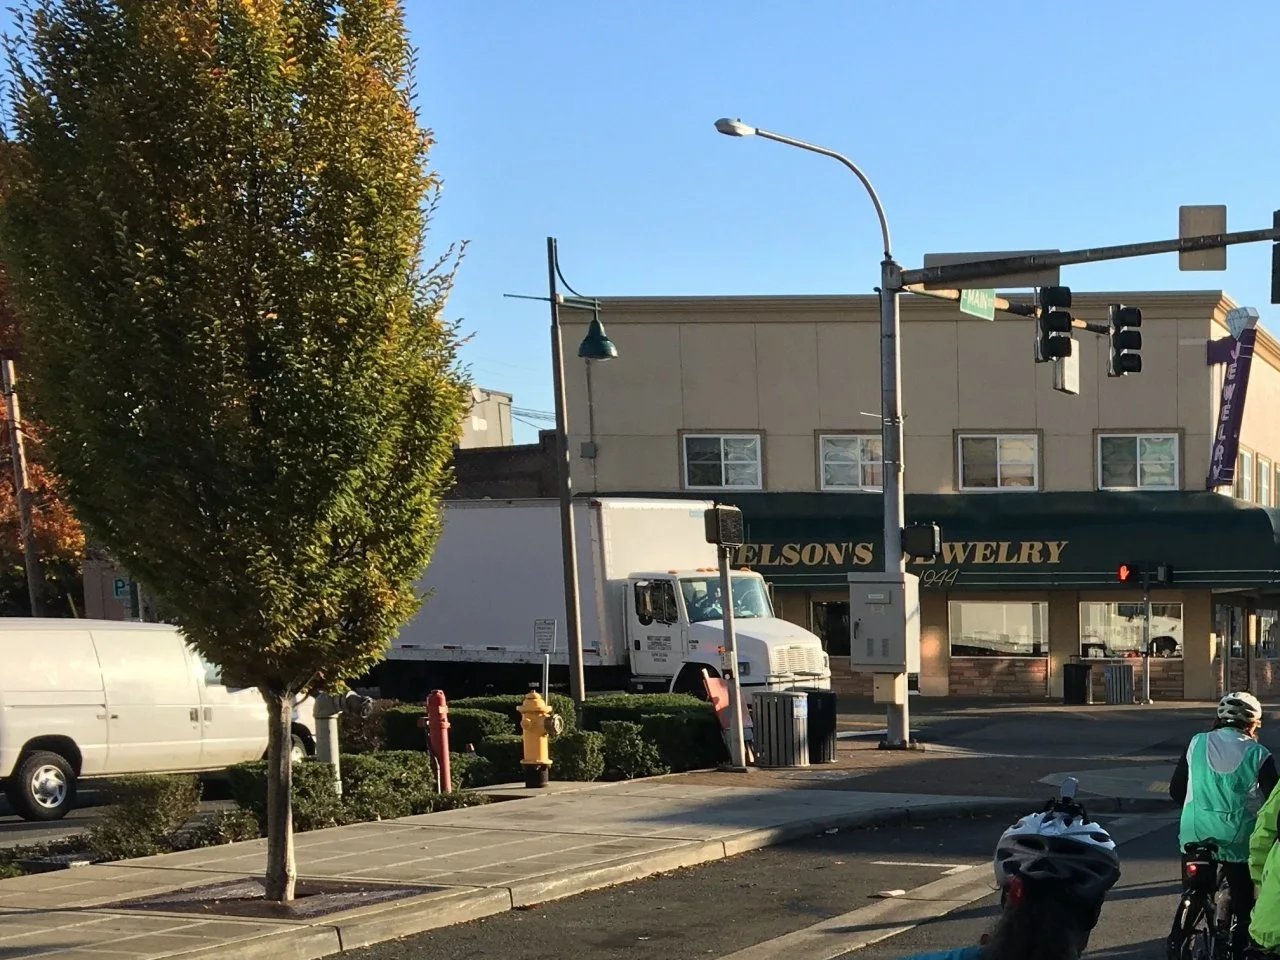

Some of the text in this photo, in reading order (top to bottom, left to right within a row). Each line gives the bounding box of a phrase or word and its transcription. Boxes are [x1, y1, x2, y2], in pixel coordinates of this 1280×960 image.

[1212, 341, 1241, 480] JEWELRY
[730, 541, 1069, 566] ELSON'S WELRY
[918, 568, 960, 588] 1944
